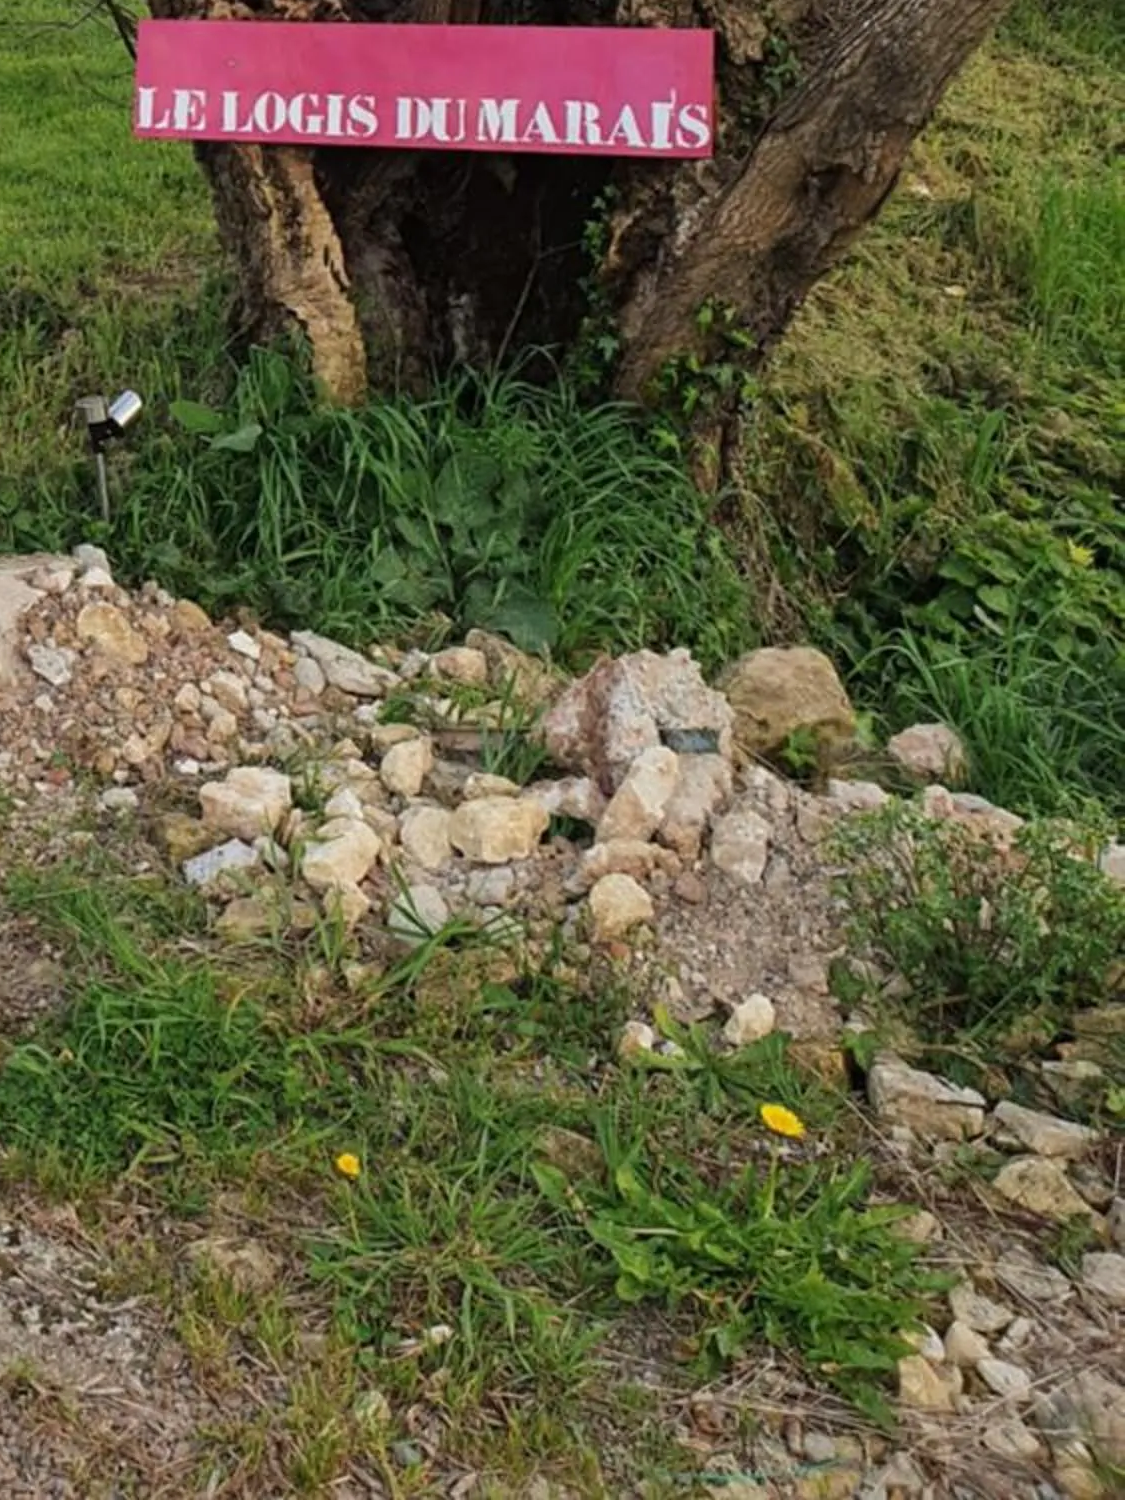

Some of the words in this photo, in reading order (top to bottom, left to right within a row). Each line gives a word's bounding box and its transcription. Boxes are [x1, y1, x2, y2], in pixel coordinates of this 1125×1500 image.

[136, 87, 206, 132] LE
[220, 91, 379, 138] LOGIS
[394, 97, 467, 141] DU
